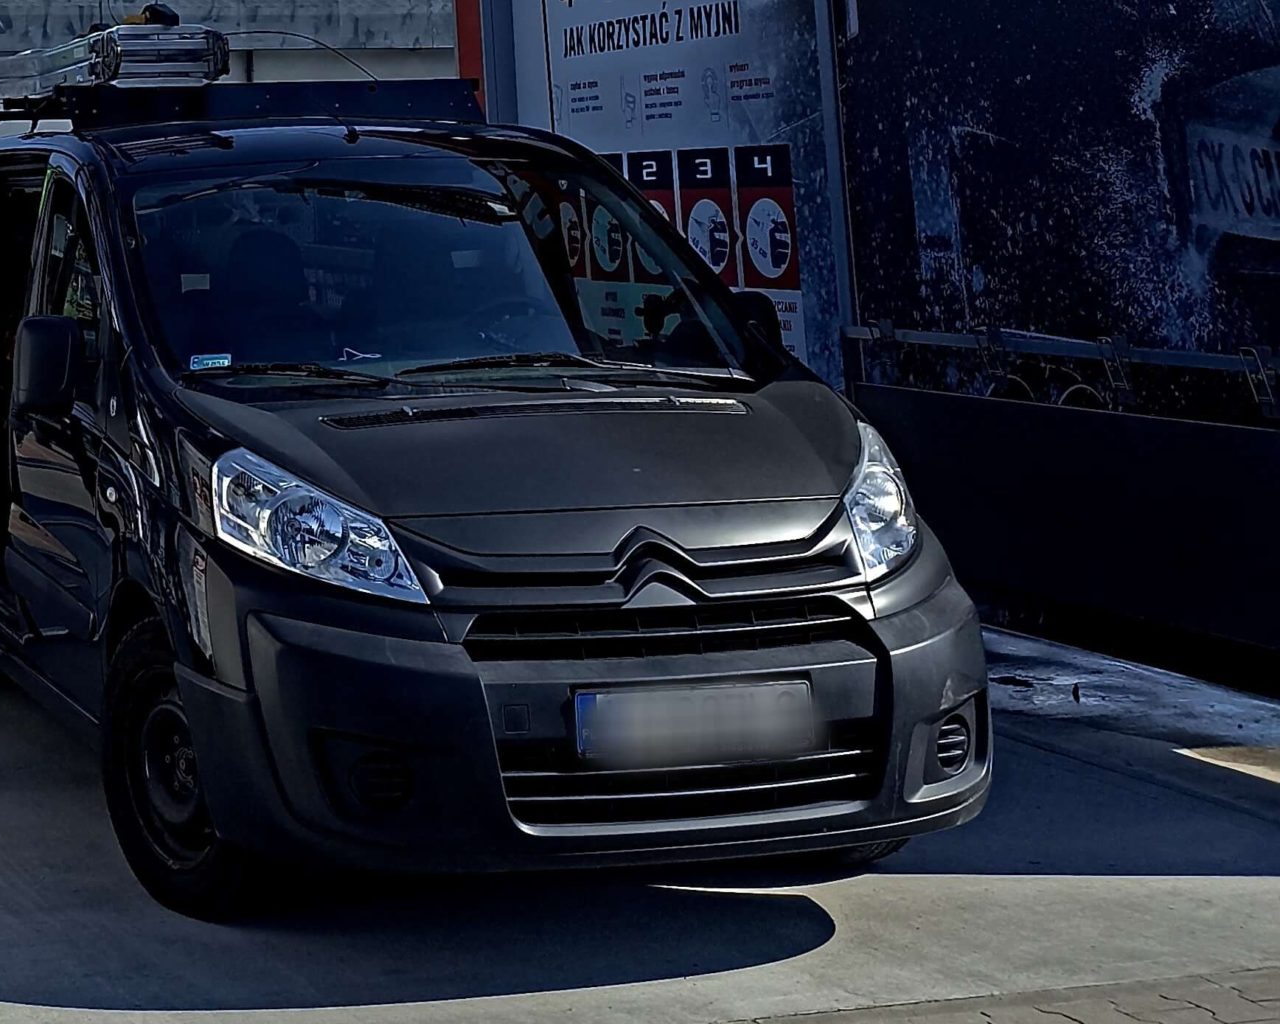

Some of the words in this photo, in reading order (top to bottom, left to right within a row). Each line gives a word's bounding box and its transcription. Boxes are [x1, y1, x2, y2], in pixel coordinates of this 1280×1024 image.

[563, 25, 585, 58] JAK
[588, 1, 670, 52] KORZYSTAĆ
[674, 9, 684, 41] Z
[689, 0, 740, 40] MYJNI
[642, 160, 657, 181] 2
[694, 158, 713, 180] 3
[753, 155, 773, 177] 4
